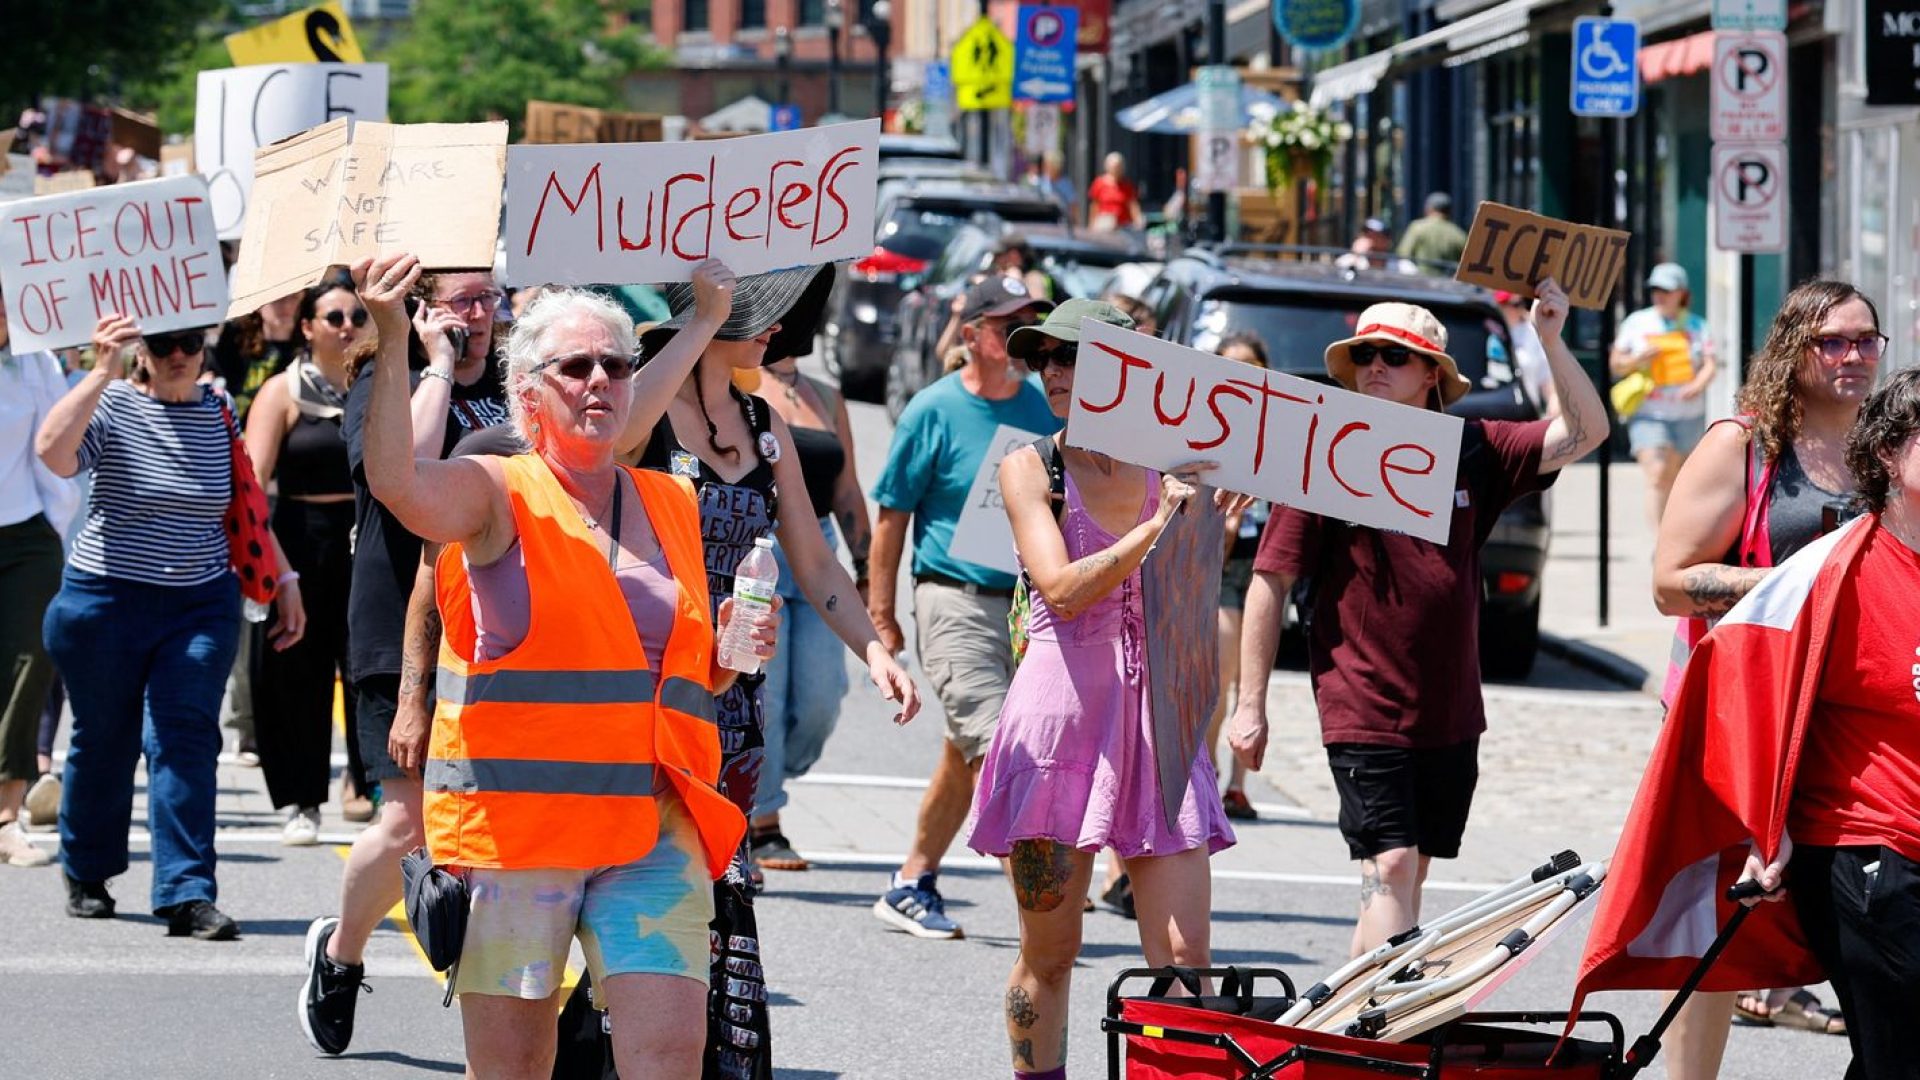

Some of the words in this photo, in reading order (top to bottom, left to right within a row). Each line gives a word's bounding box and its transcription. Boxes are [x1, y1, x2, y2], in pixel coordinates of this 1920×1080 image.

[301, 157, 359, 195] WE
[378, 159, 456, 187] ARE
[12, 206, 104, 266] ICE
[114, 197, 203, 257] OUT
[304, 220, 403, 252] SAFE
[1468, 218, 1567, 288] ICE
[1560, 232, 1627, 303] OUT
[19, 278, 69, 335] OF
[89, 252, 217, 320] MAINE
[703, 485, 758, 517] FREE
